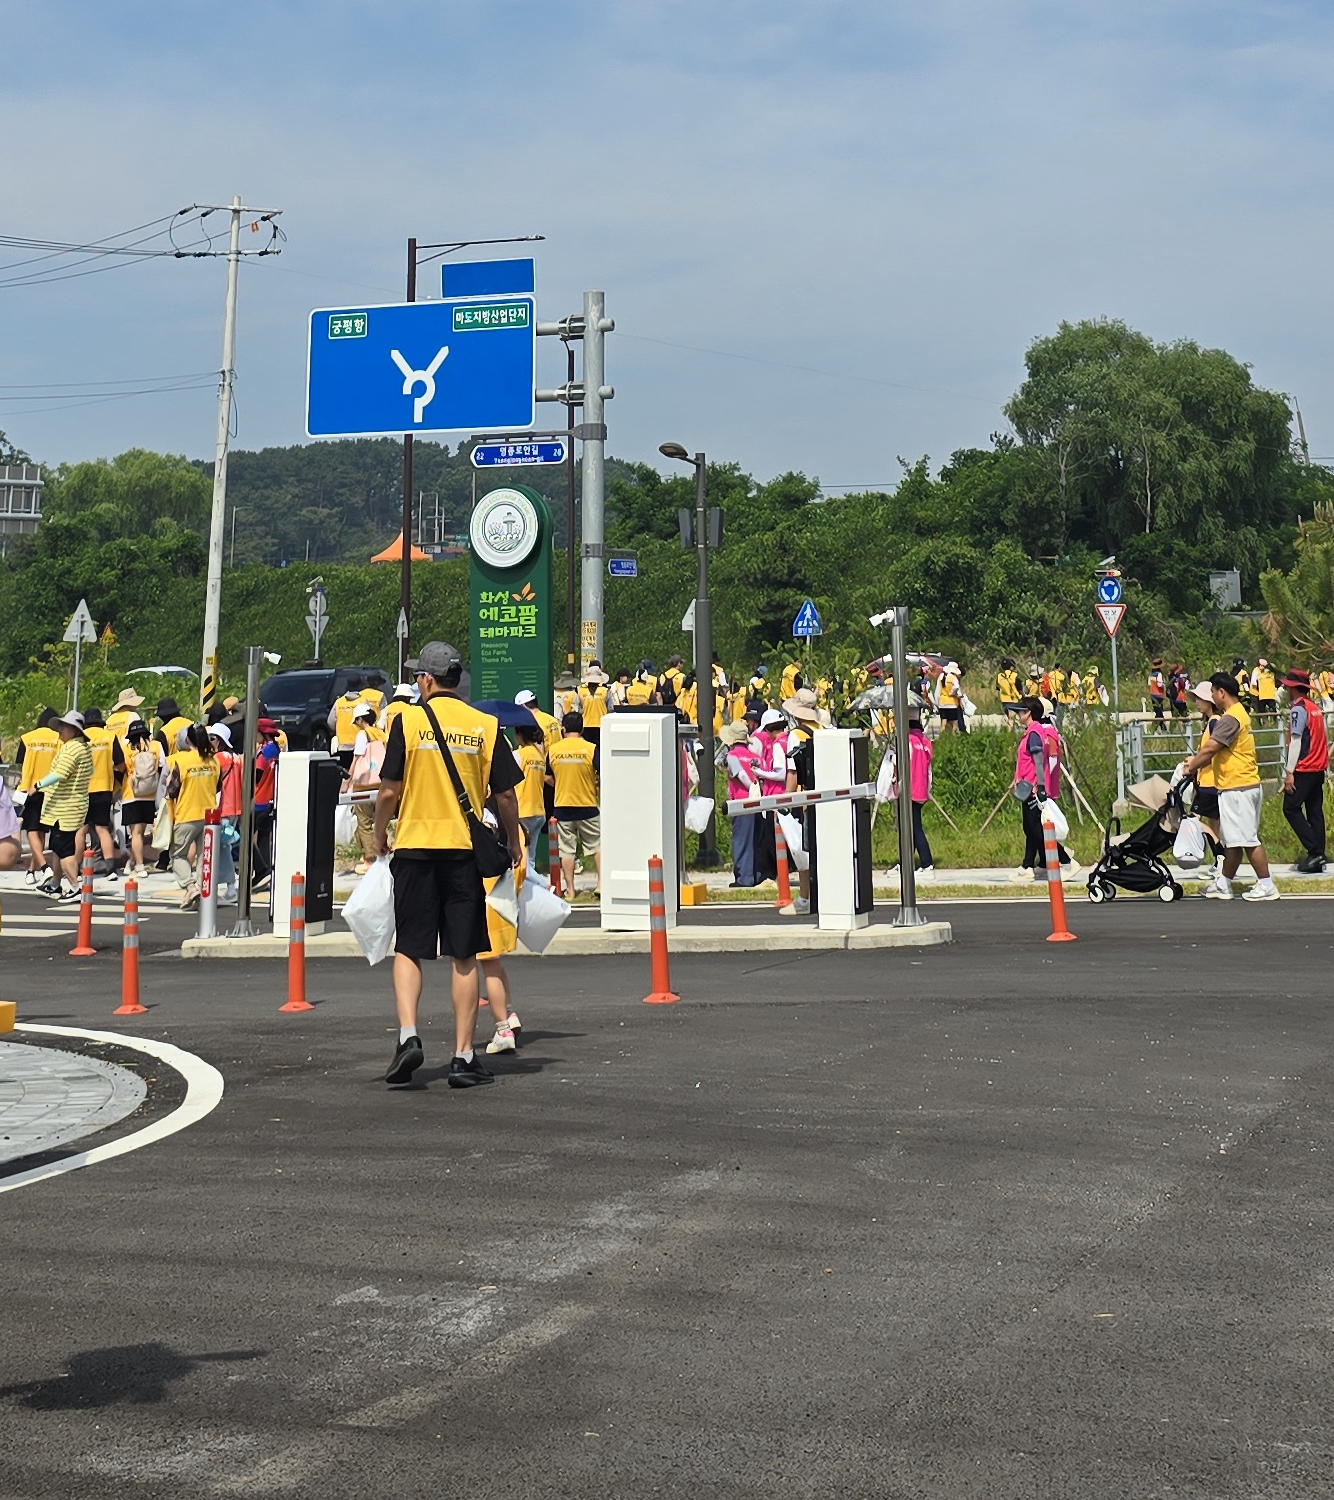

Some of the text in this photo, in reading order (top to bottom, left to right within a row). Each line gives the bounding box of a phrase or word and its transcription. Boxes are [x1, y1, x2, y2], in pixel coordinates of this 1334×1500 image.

[455, 307, 527, 325] 마도지방산업단지
[331, 319, 365, 335] 궁평항
[479, 590, 510, 605] 화성
[479, 604, 539, 625] 에코팜
[479, 625, 538, 639] 테마파크
[481, 656, 500, 664] Theme
